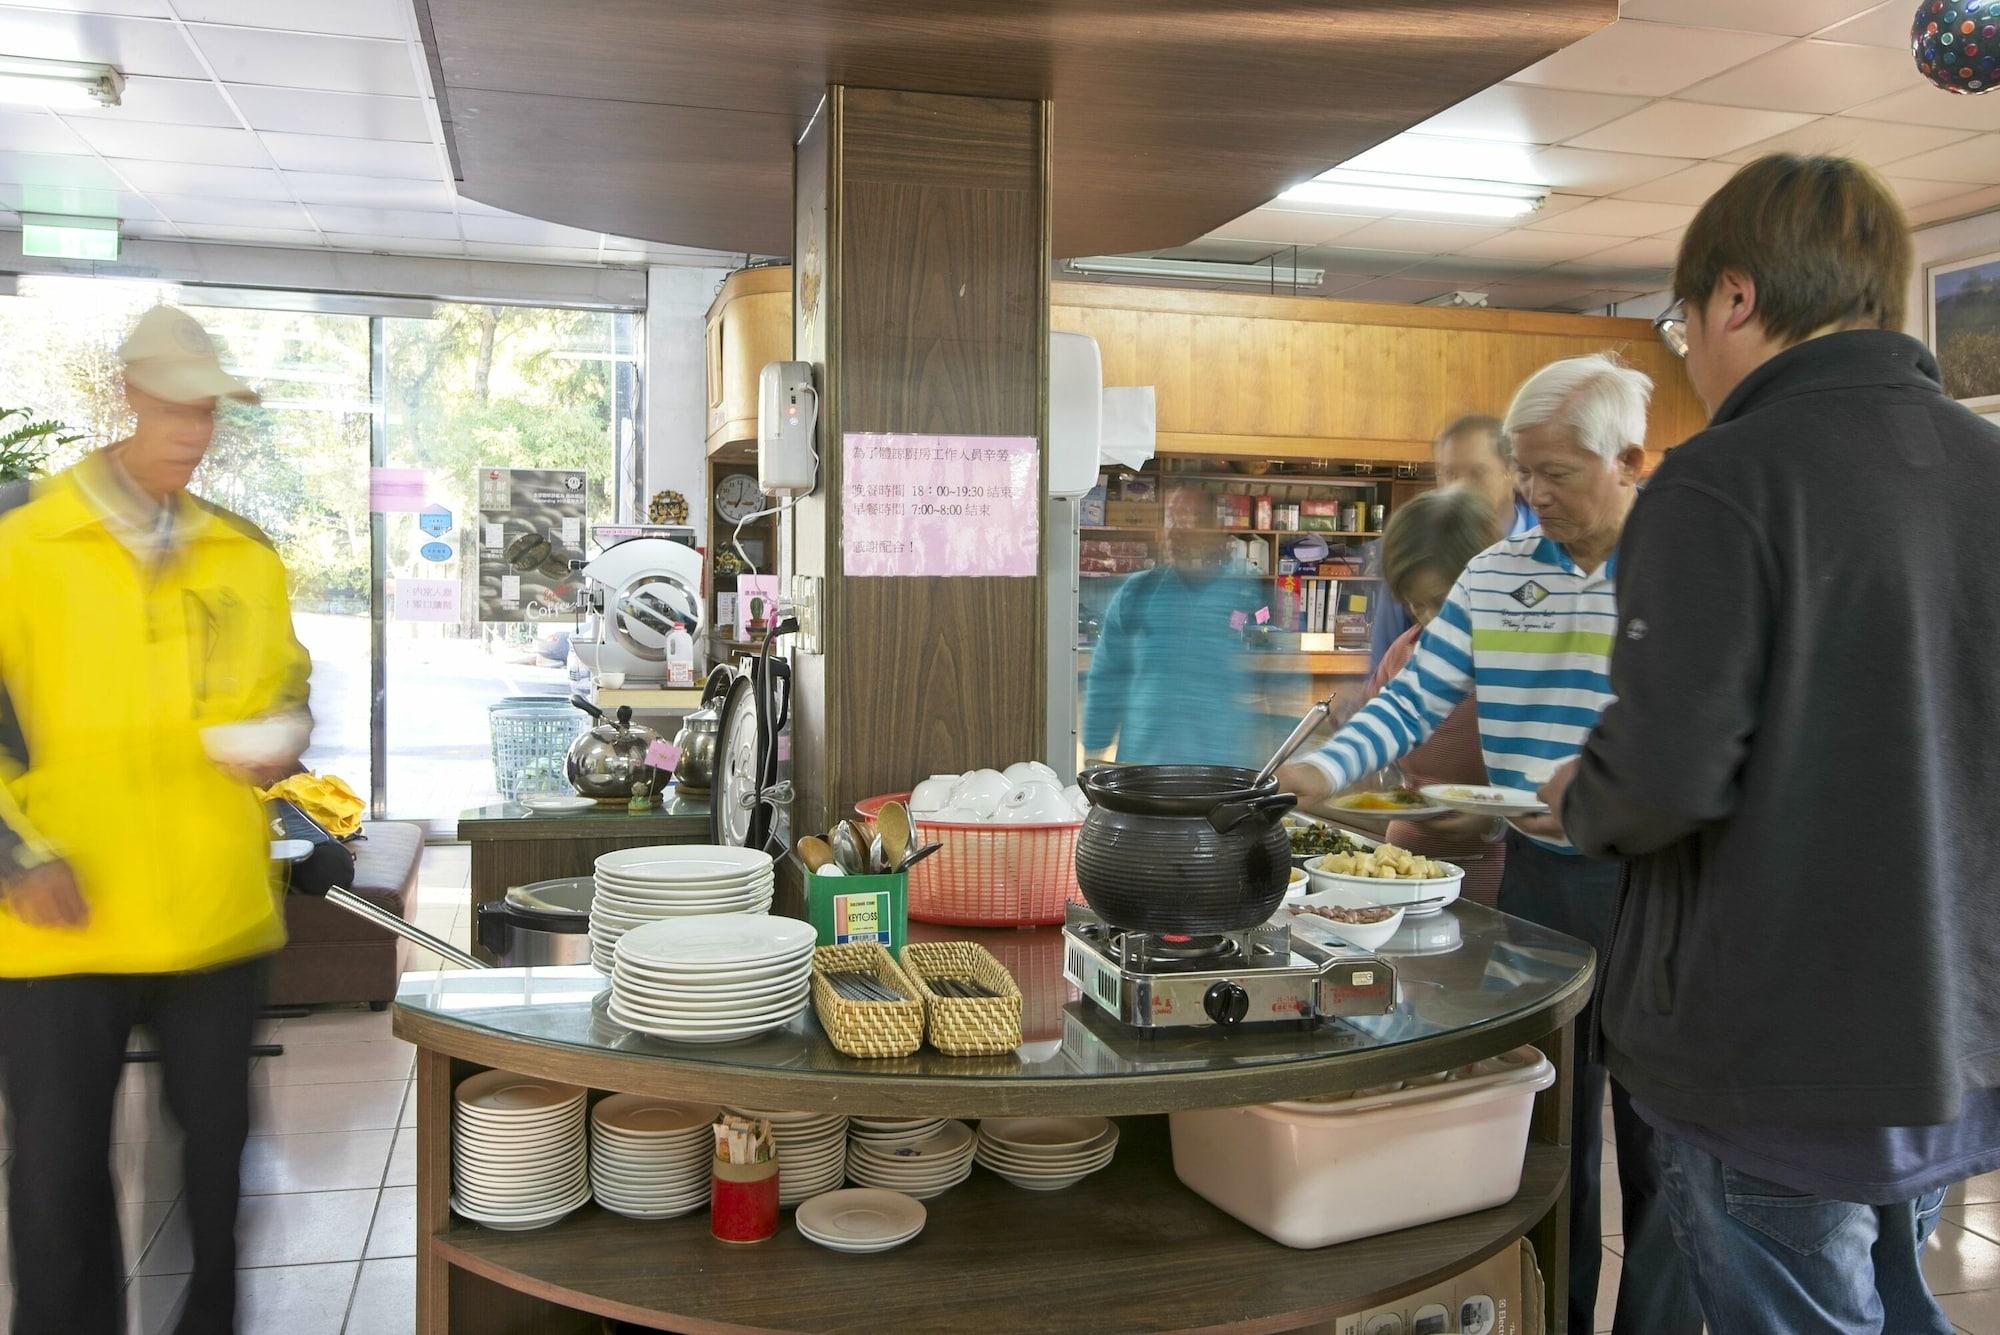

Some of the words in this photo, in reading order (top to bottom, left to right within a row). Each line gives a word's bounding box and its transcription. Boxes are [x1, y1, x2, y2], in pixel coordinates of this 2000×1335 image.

[852, 484, 905, 498] 晚餐時間
[853, 502, 905, 516] 早餐時間
[911, 503, 963, 516] 7:00~8:00
[848, 912, 879, 922] KEYTOSS
